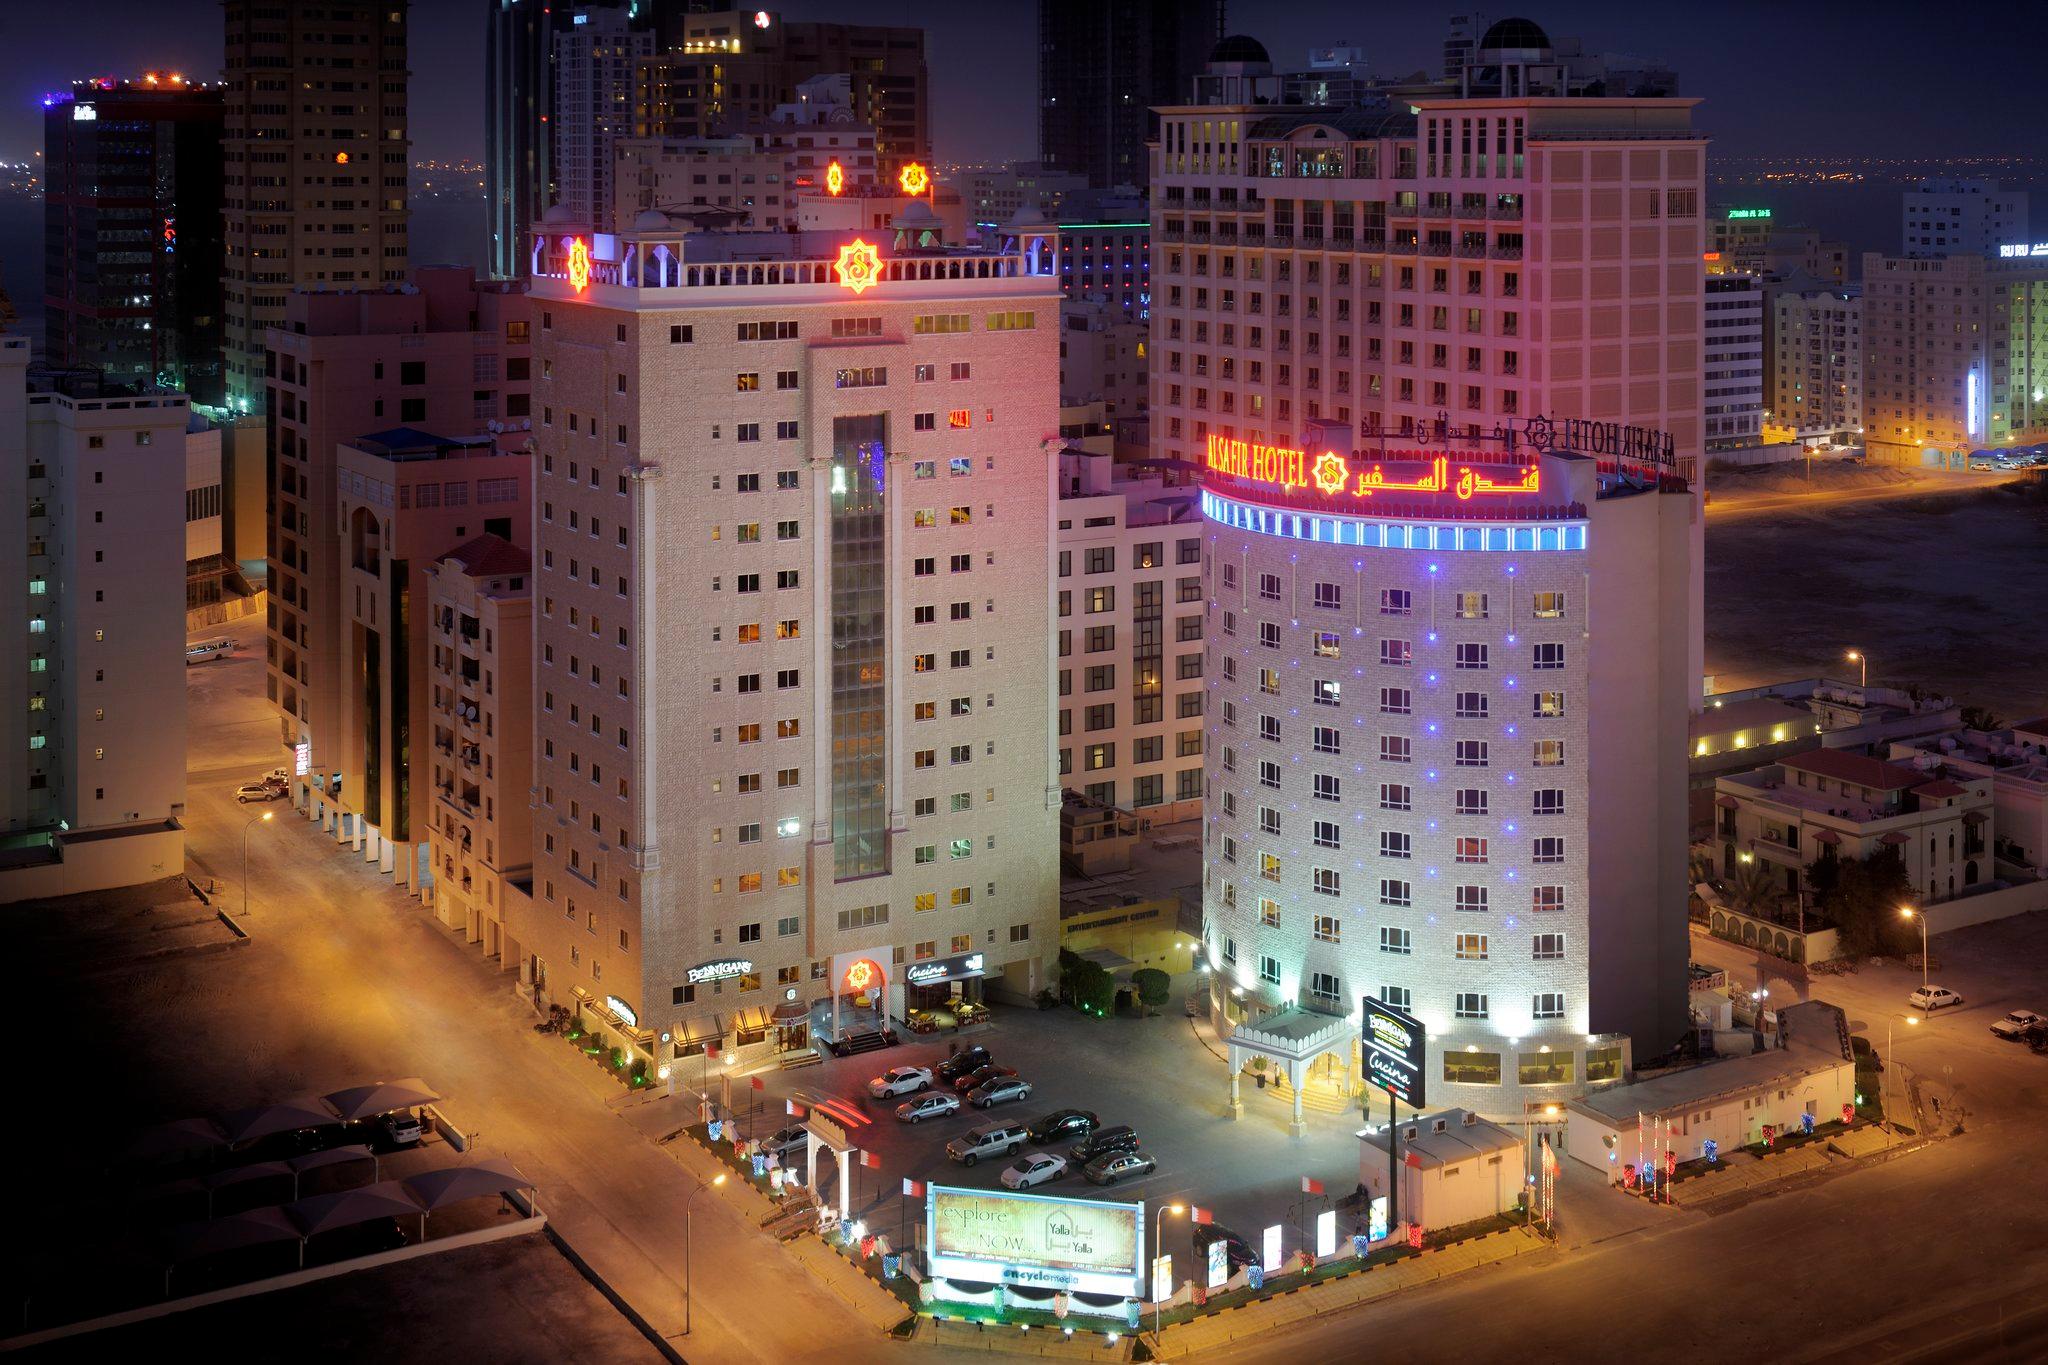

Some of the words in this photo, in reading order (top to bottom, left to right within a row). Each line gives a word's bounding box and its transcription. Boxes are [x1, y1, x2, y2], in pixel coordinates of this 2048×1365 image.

[1252, 444, 1308, 488] HOTEL
[1351, 455, 1449, 497] السفير
[1456, 464, 1540, 500] فندق
[907, 964, 948, 980] Cucina
[1369, 1050, 1411, 1085] Cucina
[943, 1201, 1008, 1228] explore
[1049, 1223, 1070, 1236] Yalla
[1072, 1241, 1093, 1254] Yalla
[1003, 1269, 1079, 1285] encyclomedia
